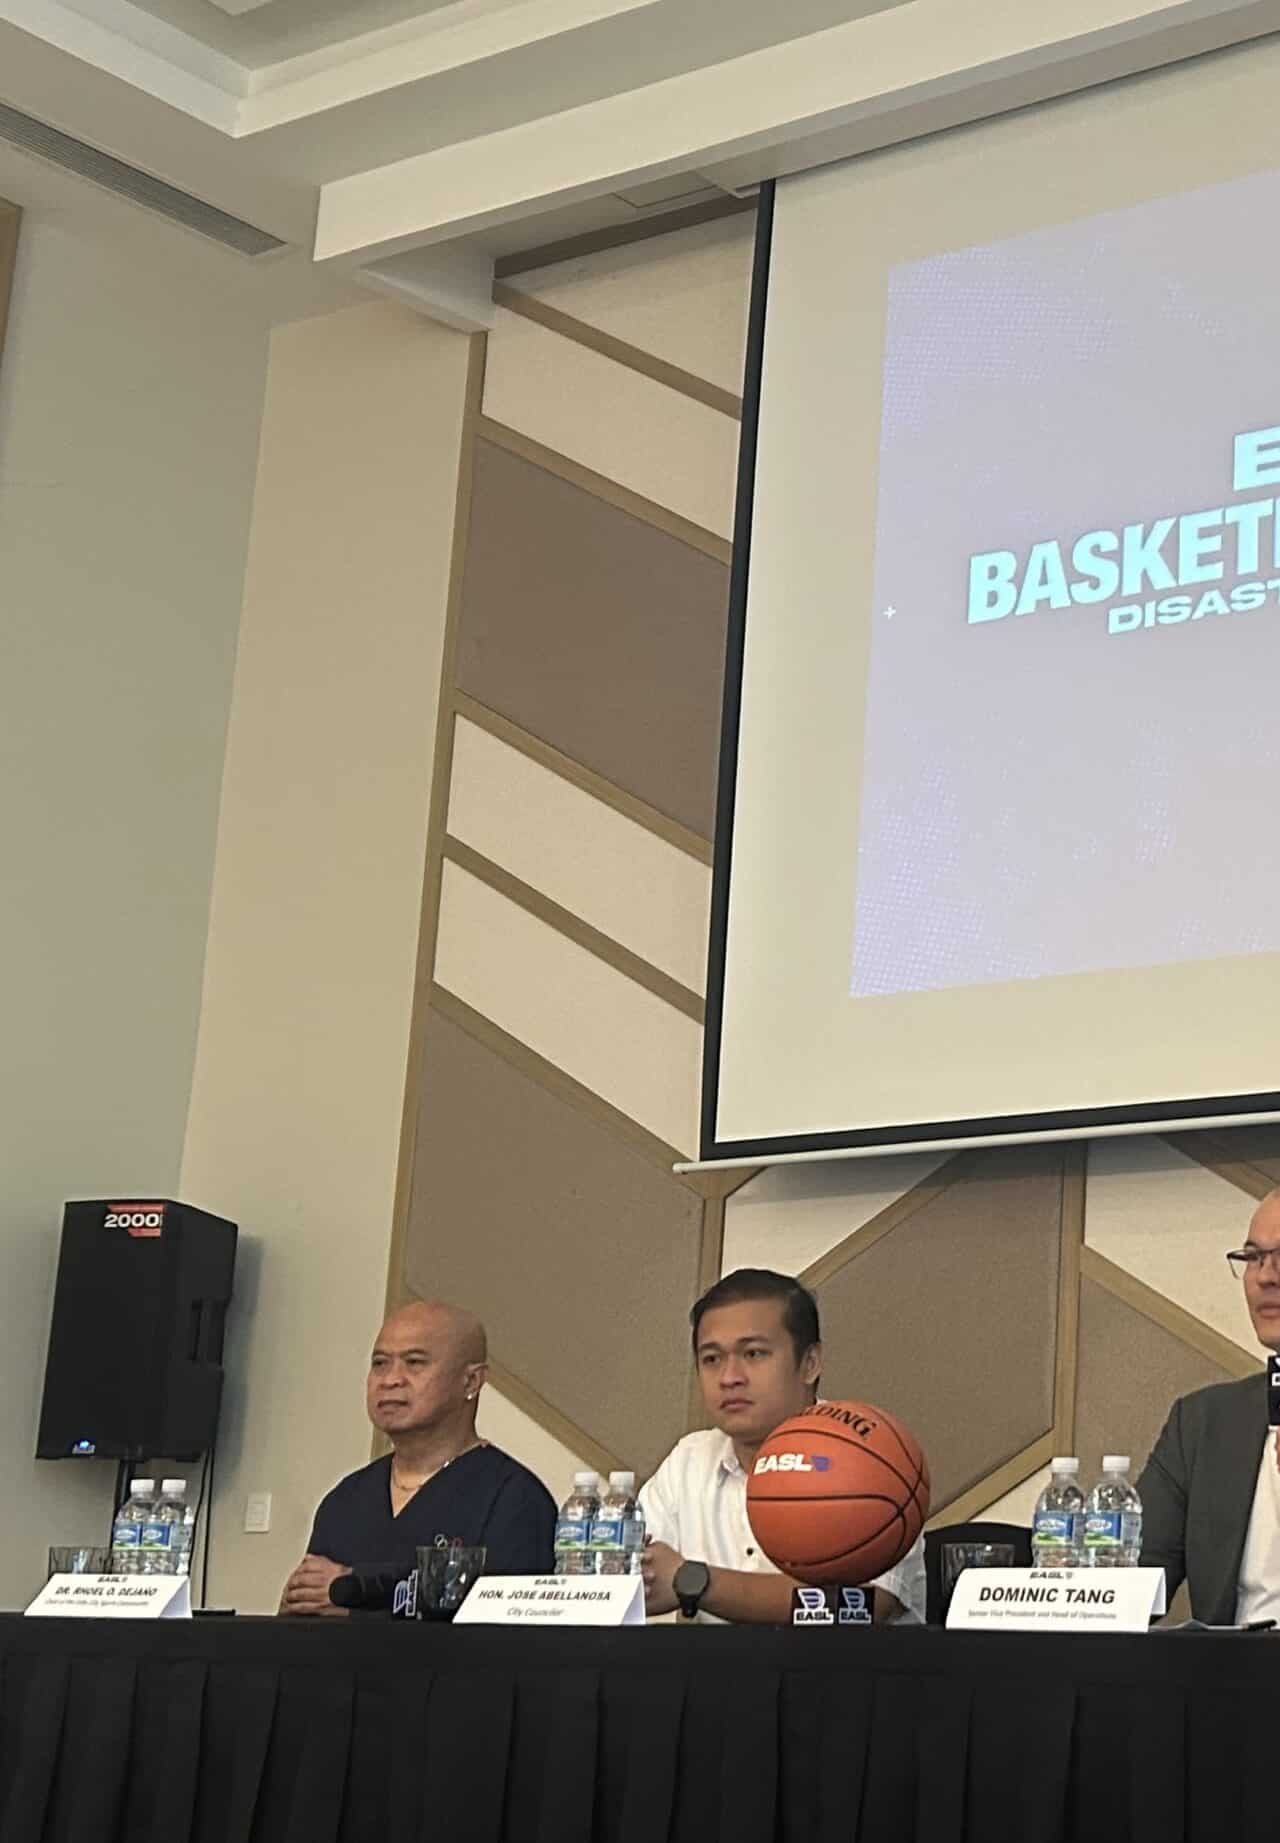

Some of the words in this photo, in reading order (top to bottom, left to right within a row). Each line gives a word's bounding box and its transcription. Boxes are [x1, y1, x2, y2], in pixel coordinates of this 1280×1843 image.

[754, 1454, 813, 1475] EASL
[478, 1590, 504, 1600] HON.
[507, 1590, 537, 1600] JOSE
[538, 1591, 612, 1601] ABELLANOSA
[979, 1587, 1058, 1602] DOMINIC
[1065, 1589, 1116, 1604] TANG
[796, 1611, 832, 1622] EASL
[840, 1611, 871, 1622] EASL
